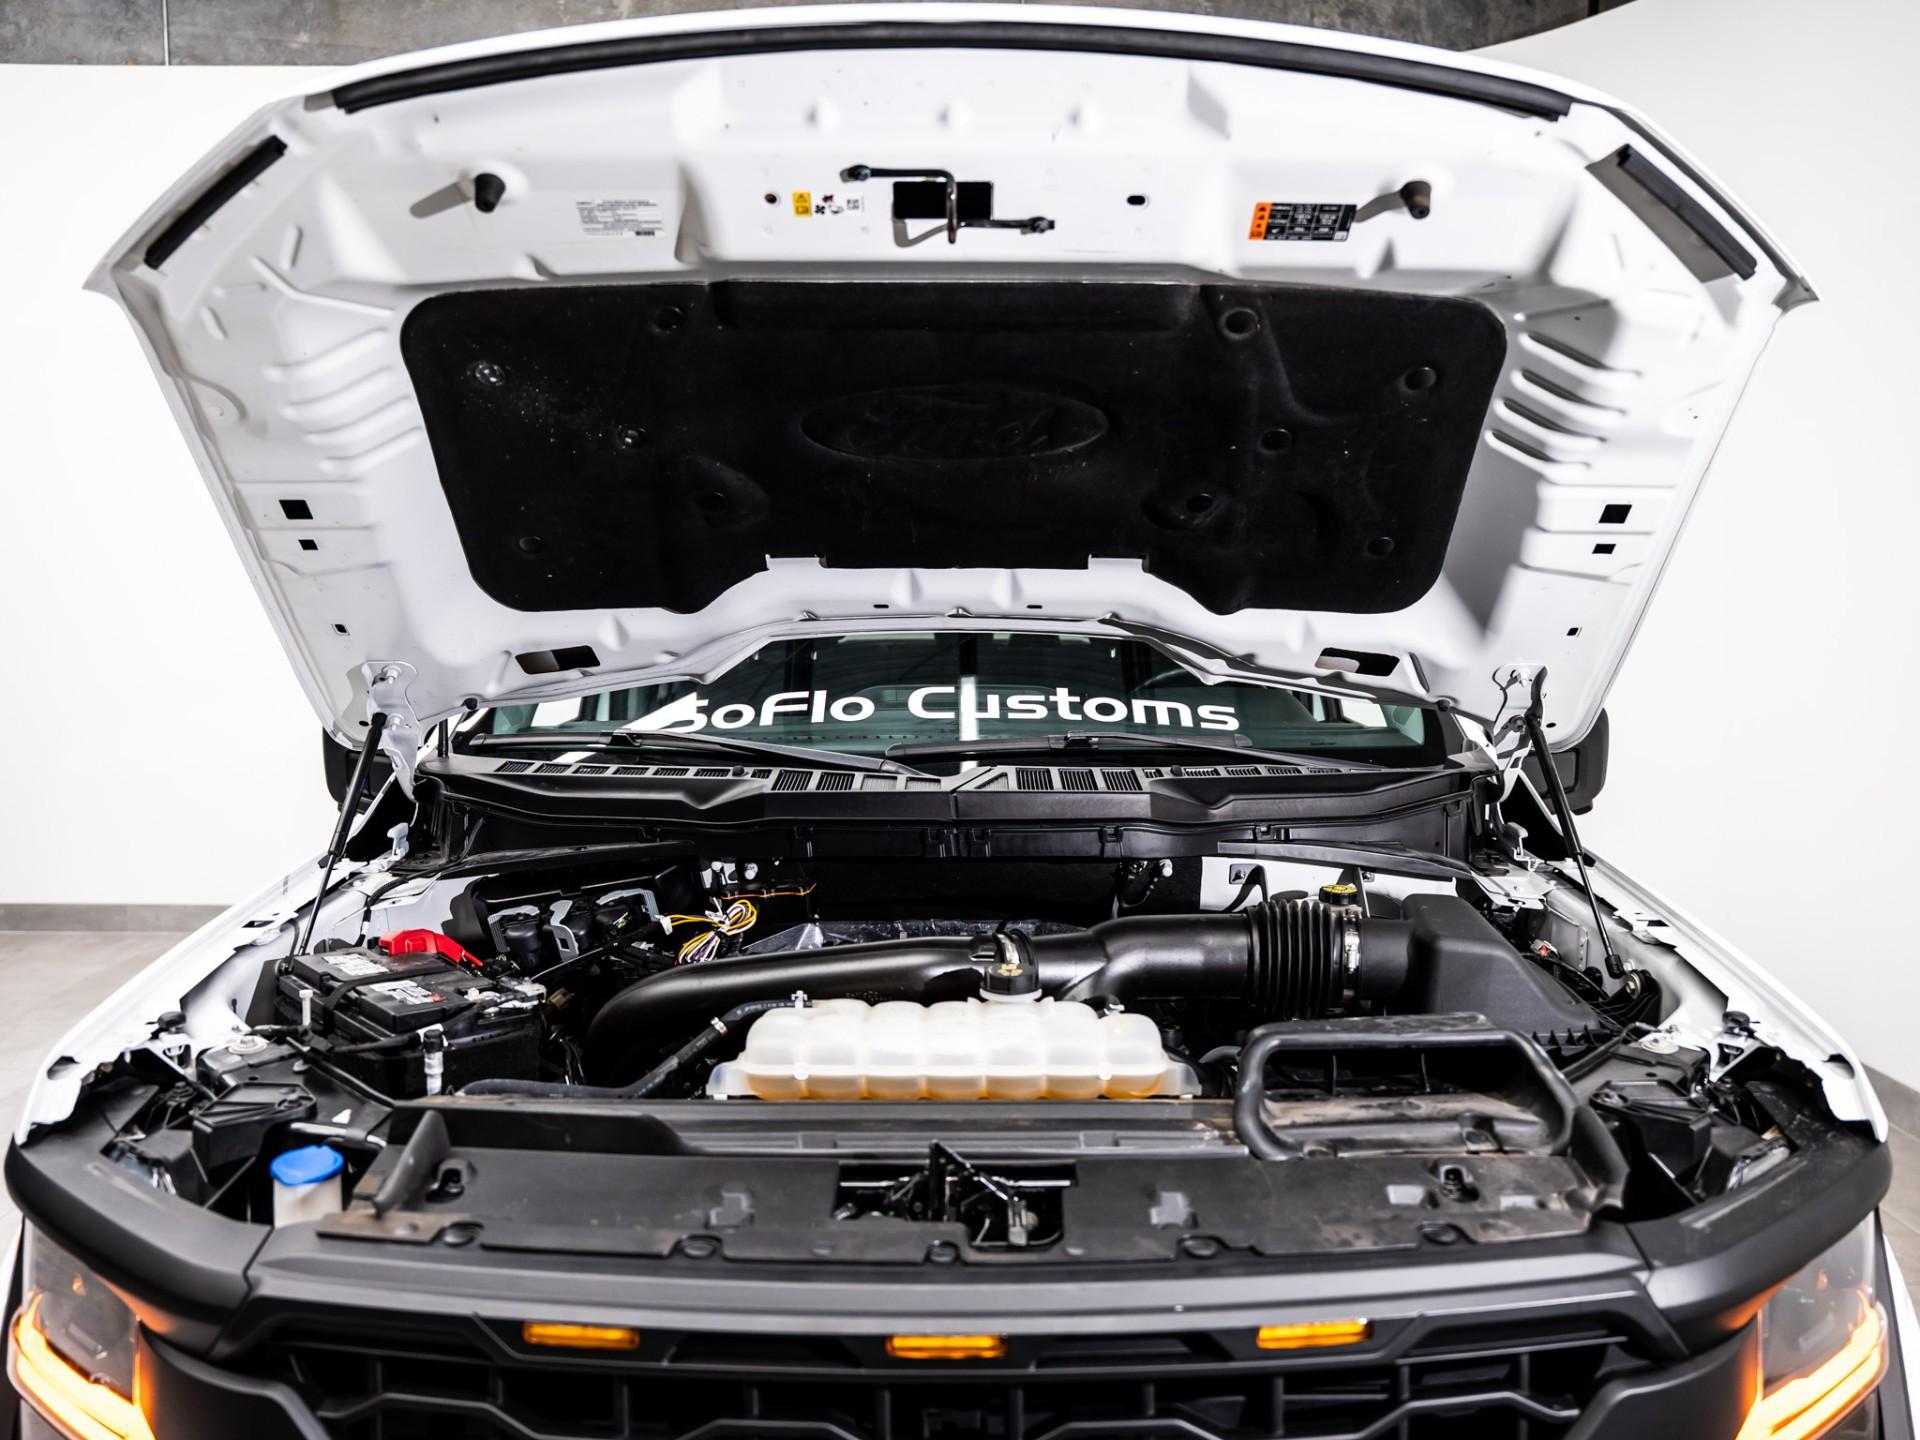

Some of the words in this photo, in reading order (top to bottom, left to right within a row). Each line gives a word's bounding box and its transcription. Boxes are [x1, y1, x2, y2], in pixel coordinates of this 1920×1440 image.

[845, 391, 1056, 452] Ford
[664, 690, 875, 734] SoFlo
[907, 686, 1240, 732] Customs
